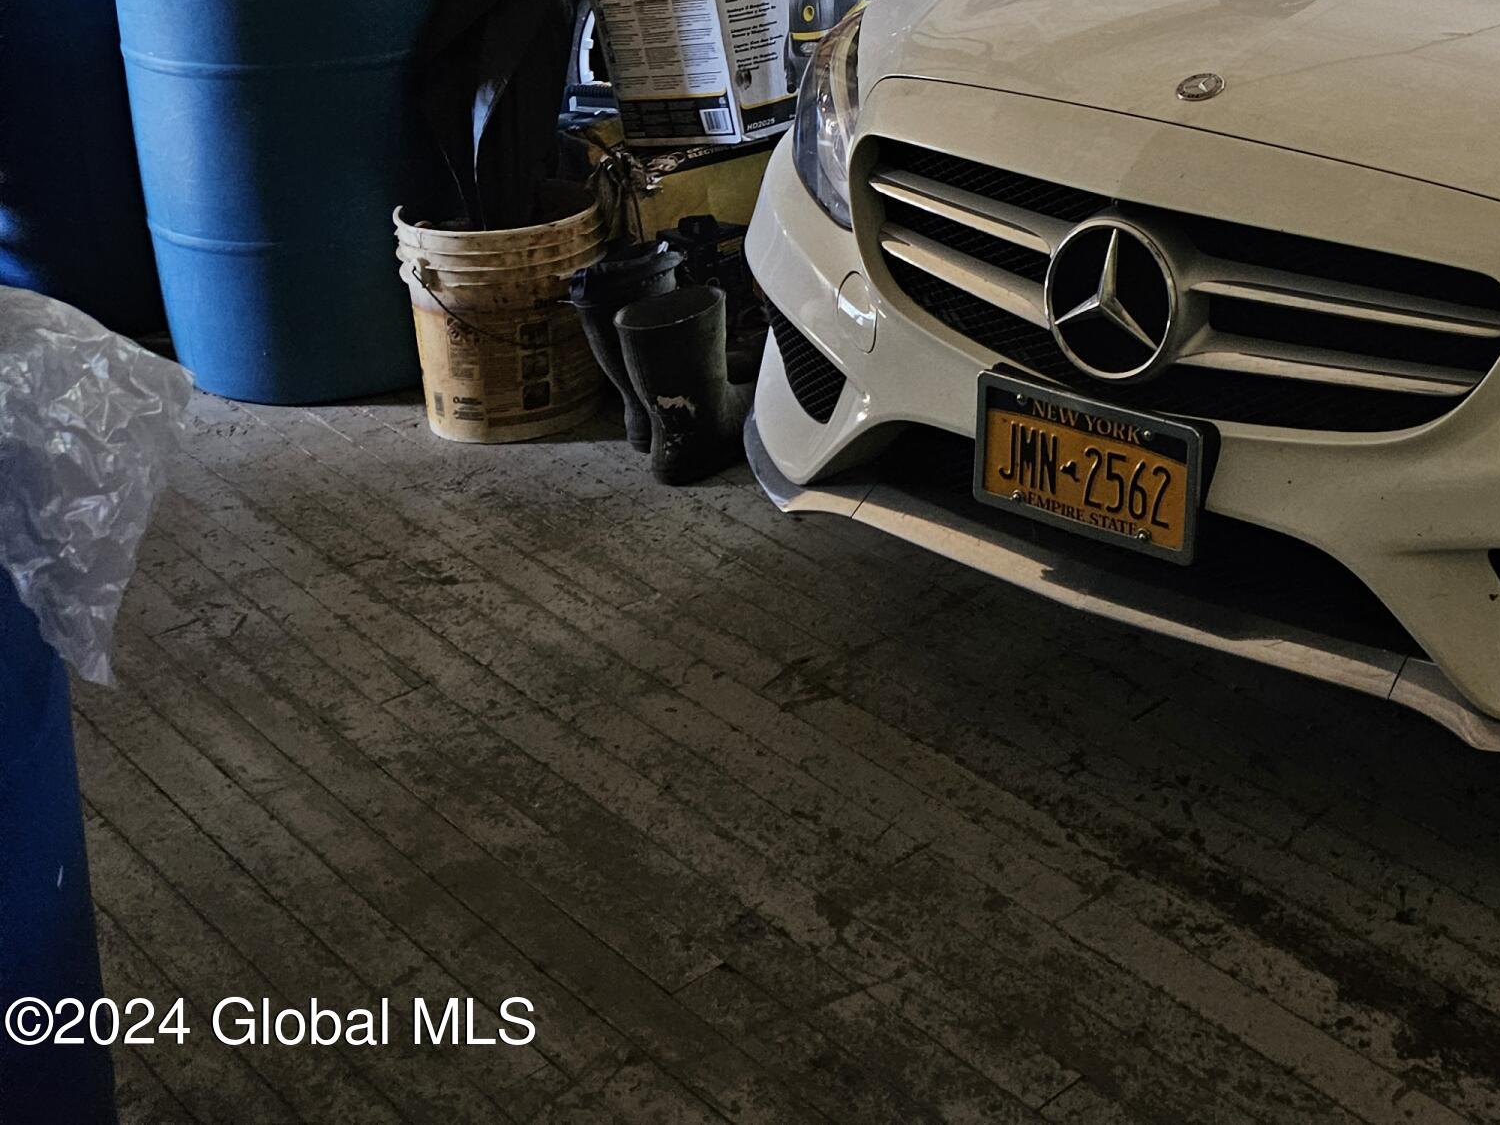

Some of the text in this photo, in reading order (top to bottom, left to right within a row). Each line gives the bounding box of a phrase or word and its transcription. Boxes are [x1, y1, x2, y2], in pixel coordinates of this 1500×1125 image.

[746, 117, 776, 132] HD2025
[1032, 401, 1142, 446] NEW YORK
[998, 421, 1172, 529] JMN 2562
[1029, 492, 1137, 537] EMPIRE STATE
